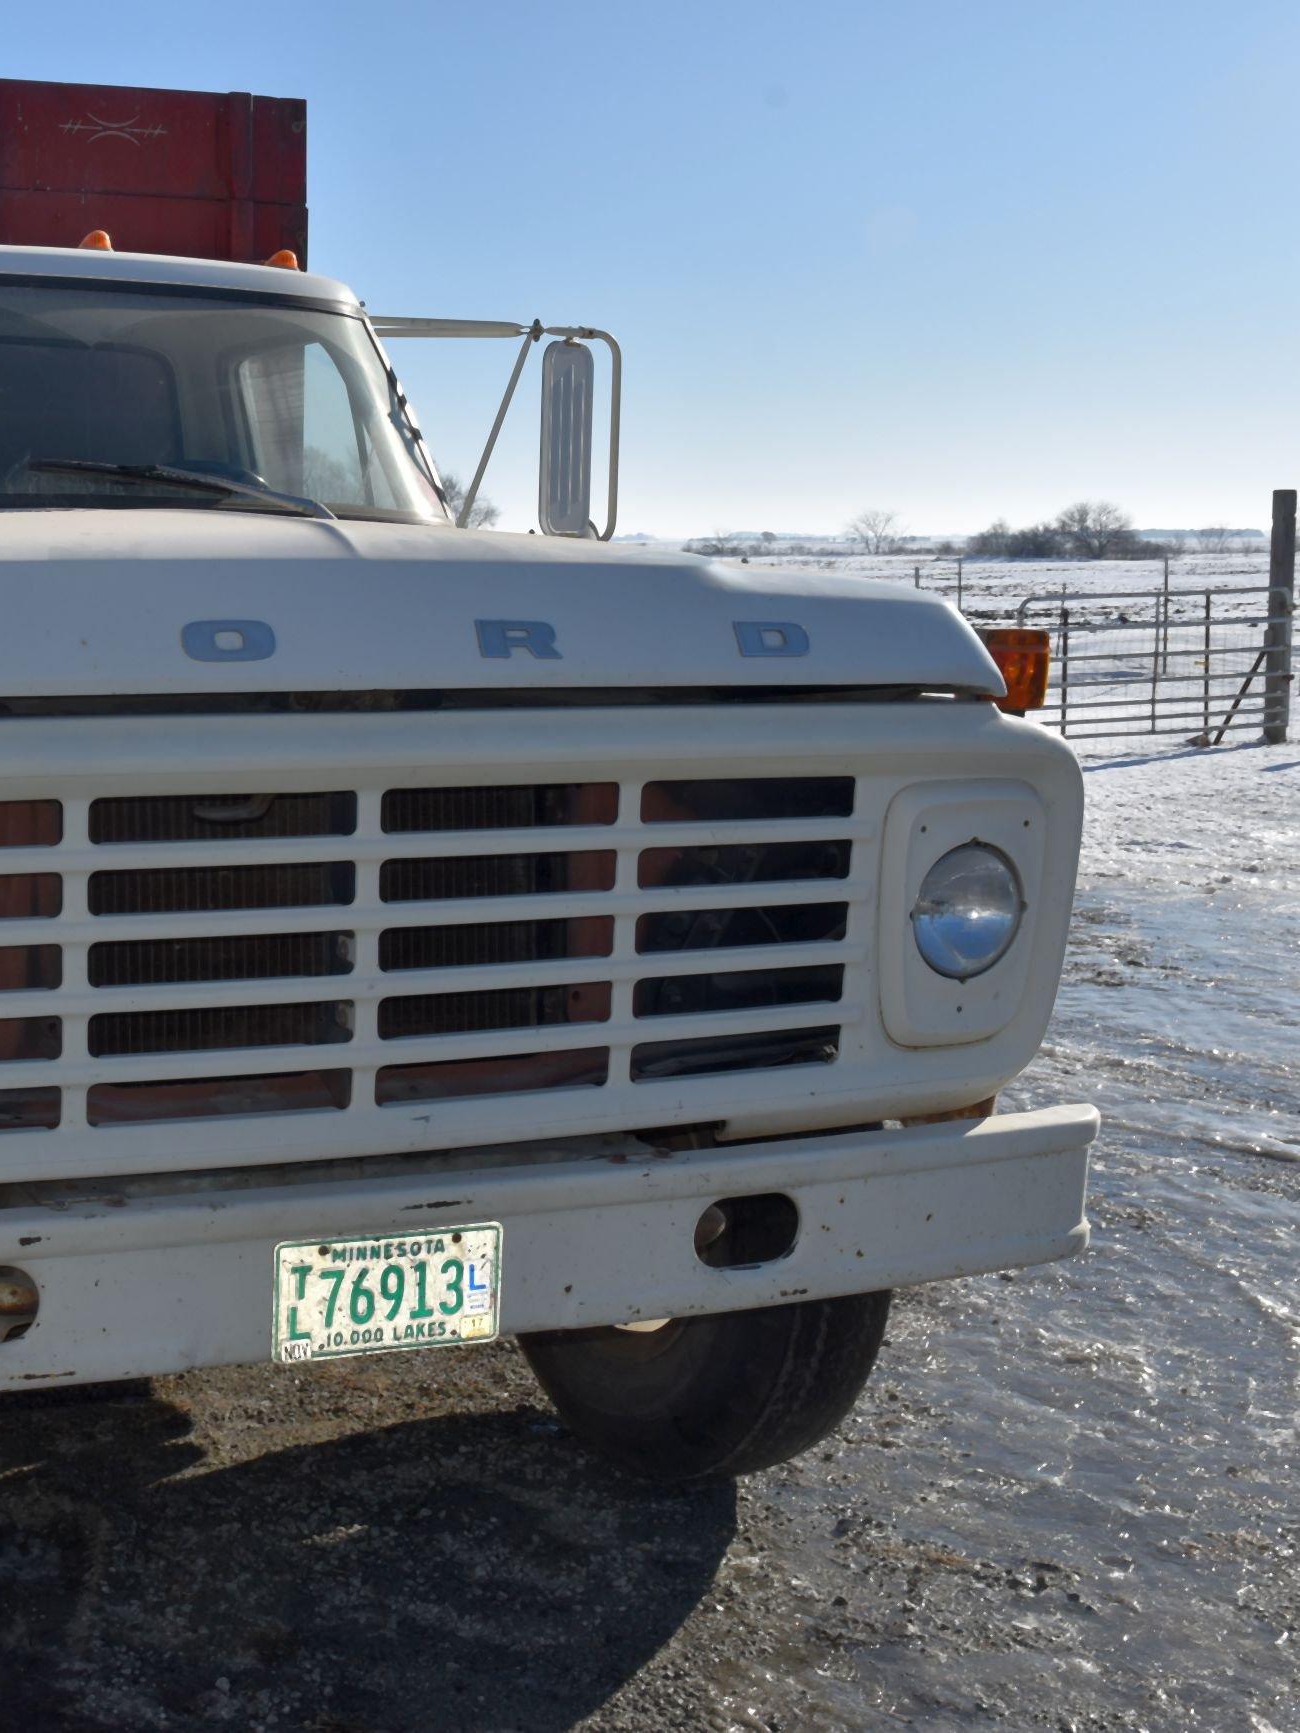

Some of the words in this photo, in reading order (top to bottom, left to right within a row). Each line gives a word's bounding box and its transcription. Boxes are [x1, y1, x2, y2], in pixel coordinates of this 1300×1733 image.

[332, 1239, 445, 1262] MINNESOTA
[319, 1259, 464, 1328] 76913
[393, 1322, 446, 1341] LAKES
